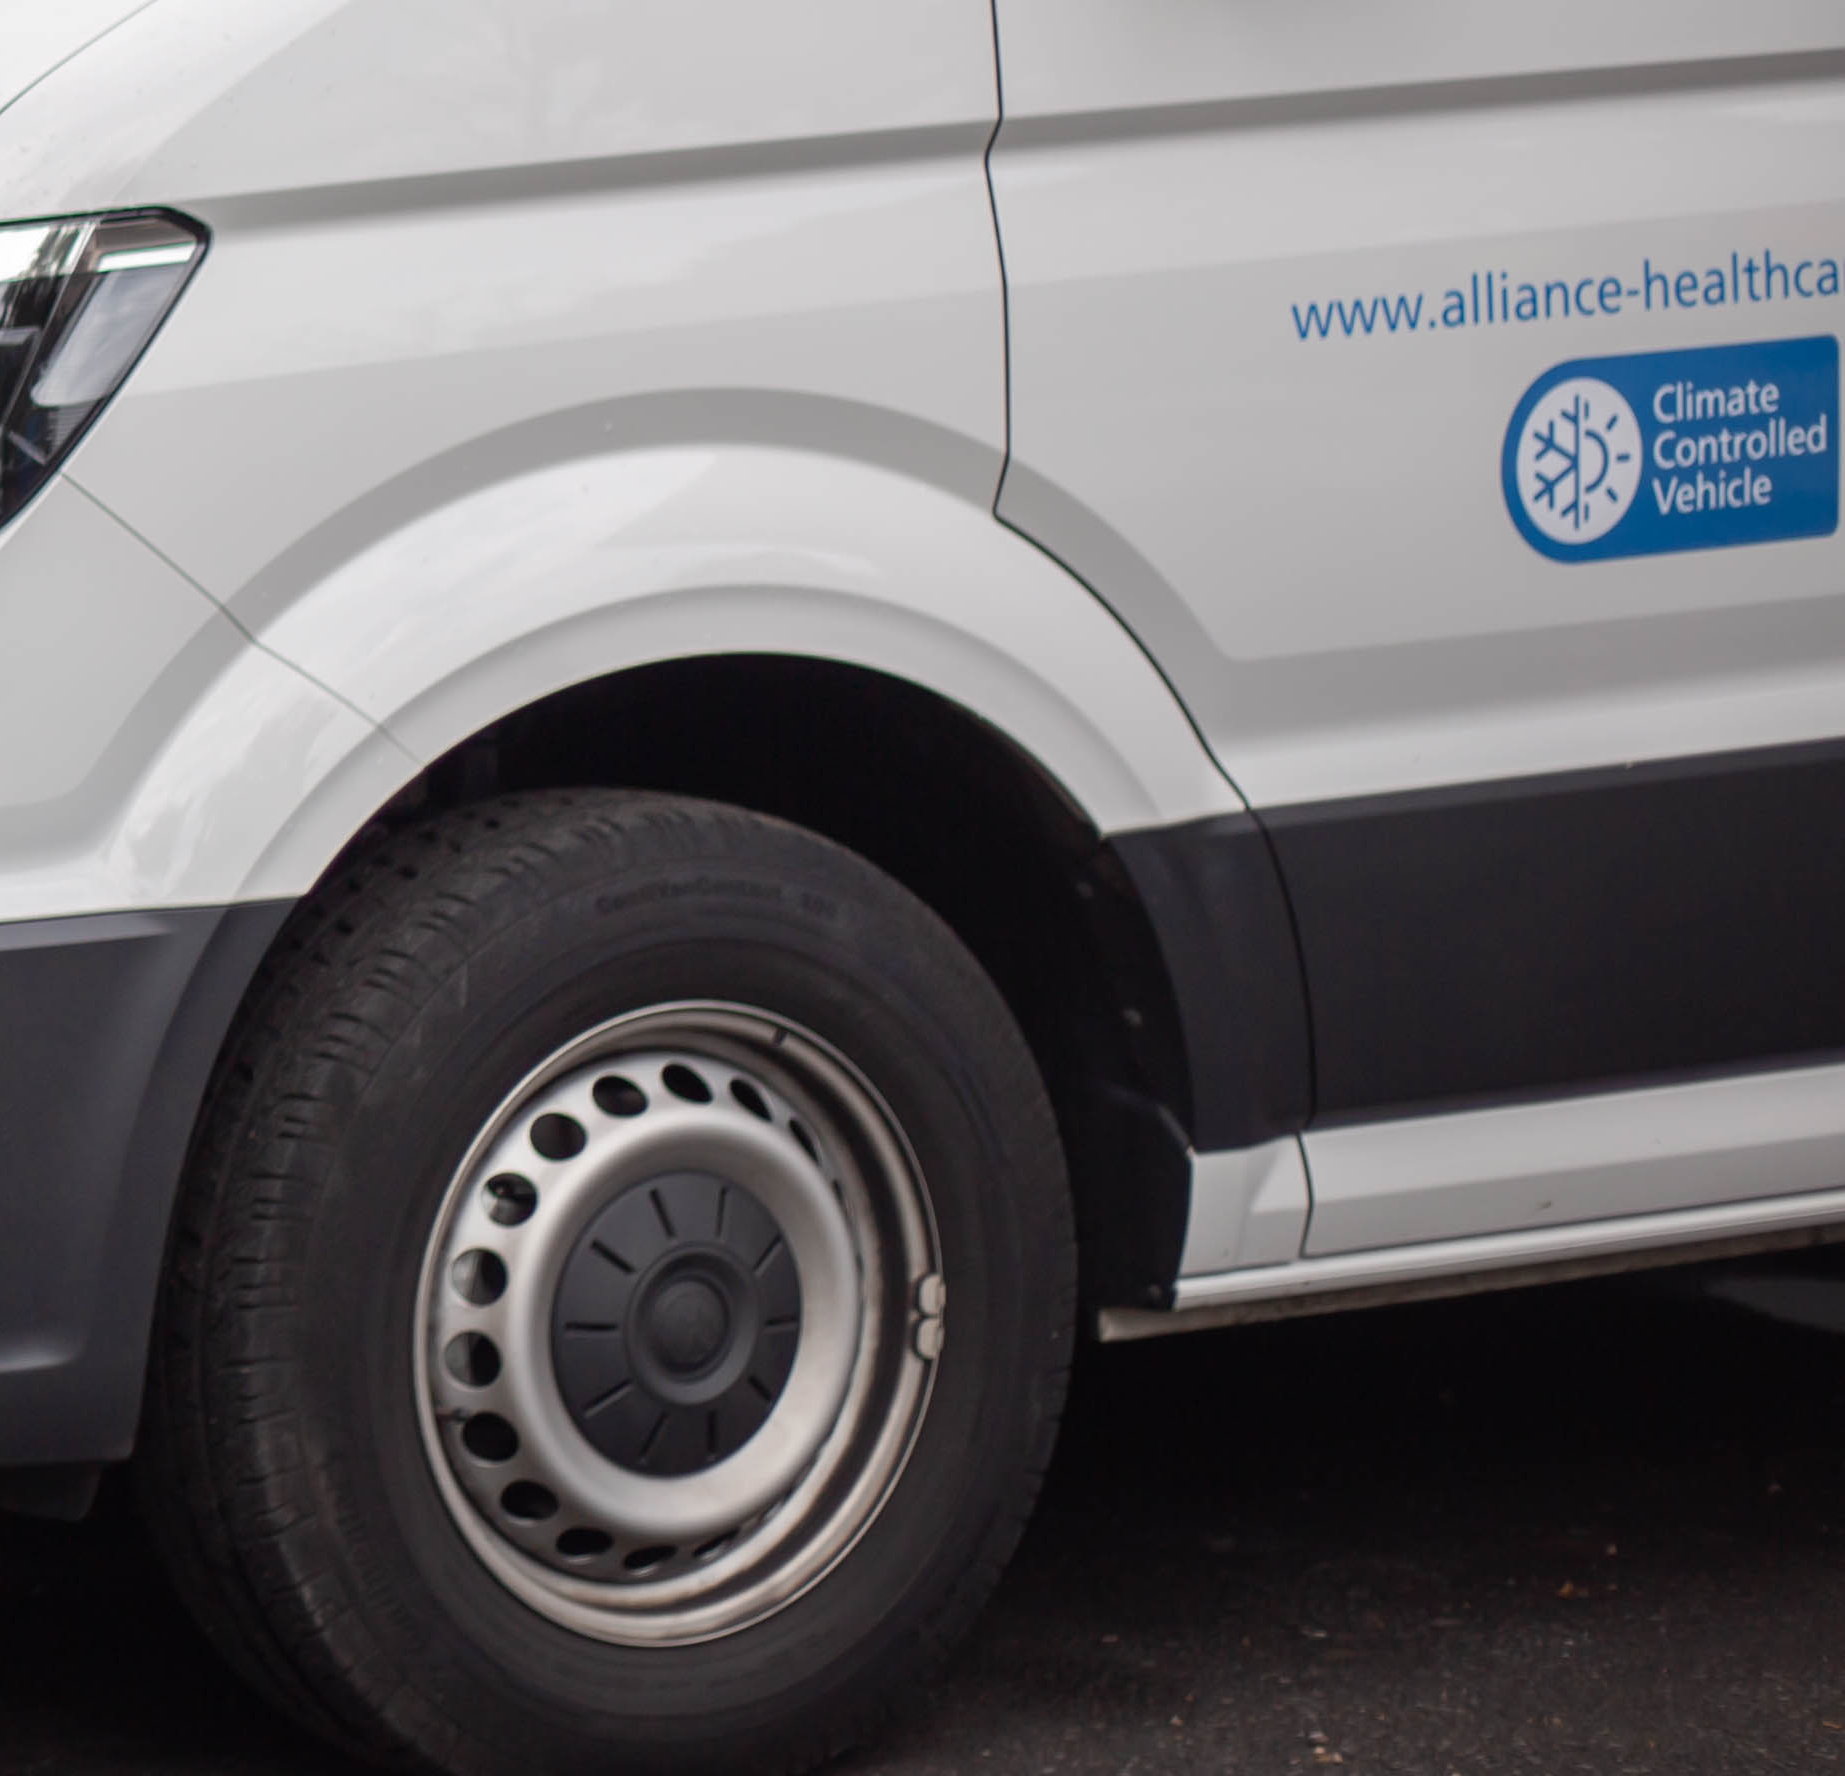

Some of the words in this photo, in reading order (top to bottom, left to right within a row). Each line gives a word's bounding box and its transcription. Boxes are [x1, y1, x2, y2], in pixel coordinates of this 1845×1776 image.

[1291, 248, 1845, 341] www.alliance-healthca
[1652, 378, 1781, 424] Climate
[1652, 414, 1829, 470] Controlled
[1652, 468, 1773, 516] Vehicle
